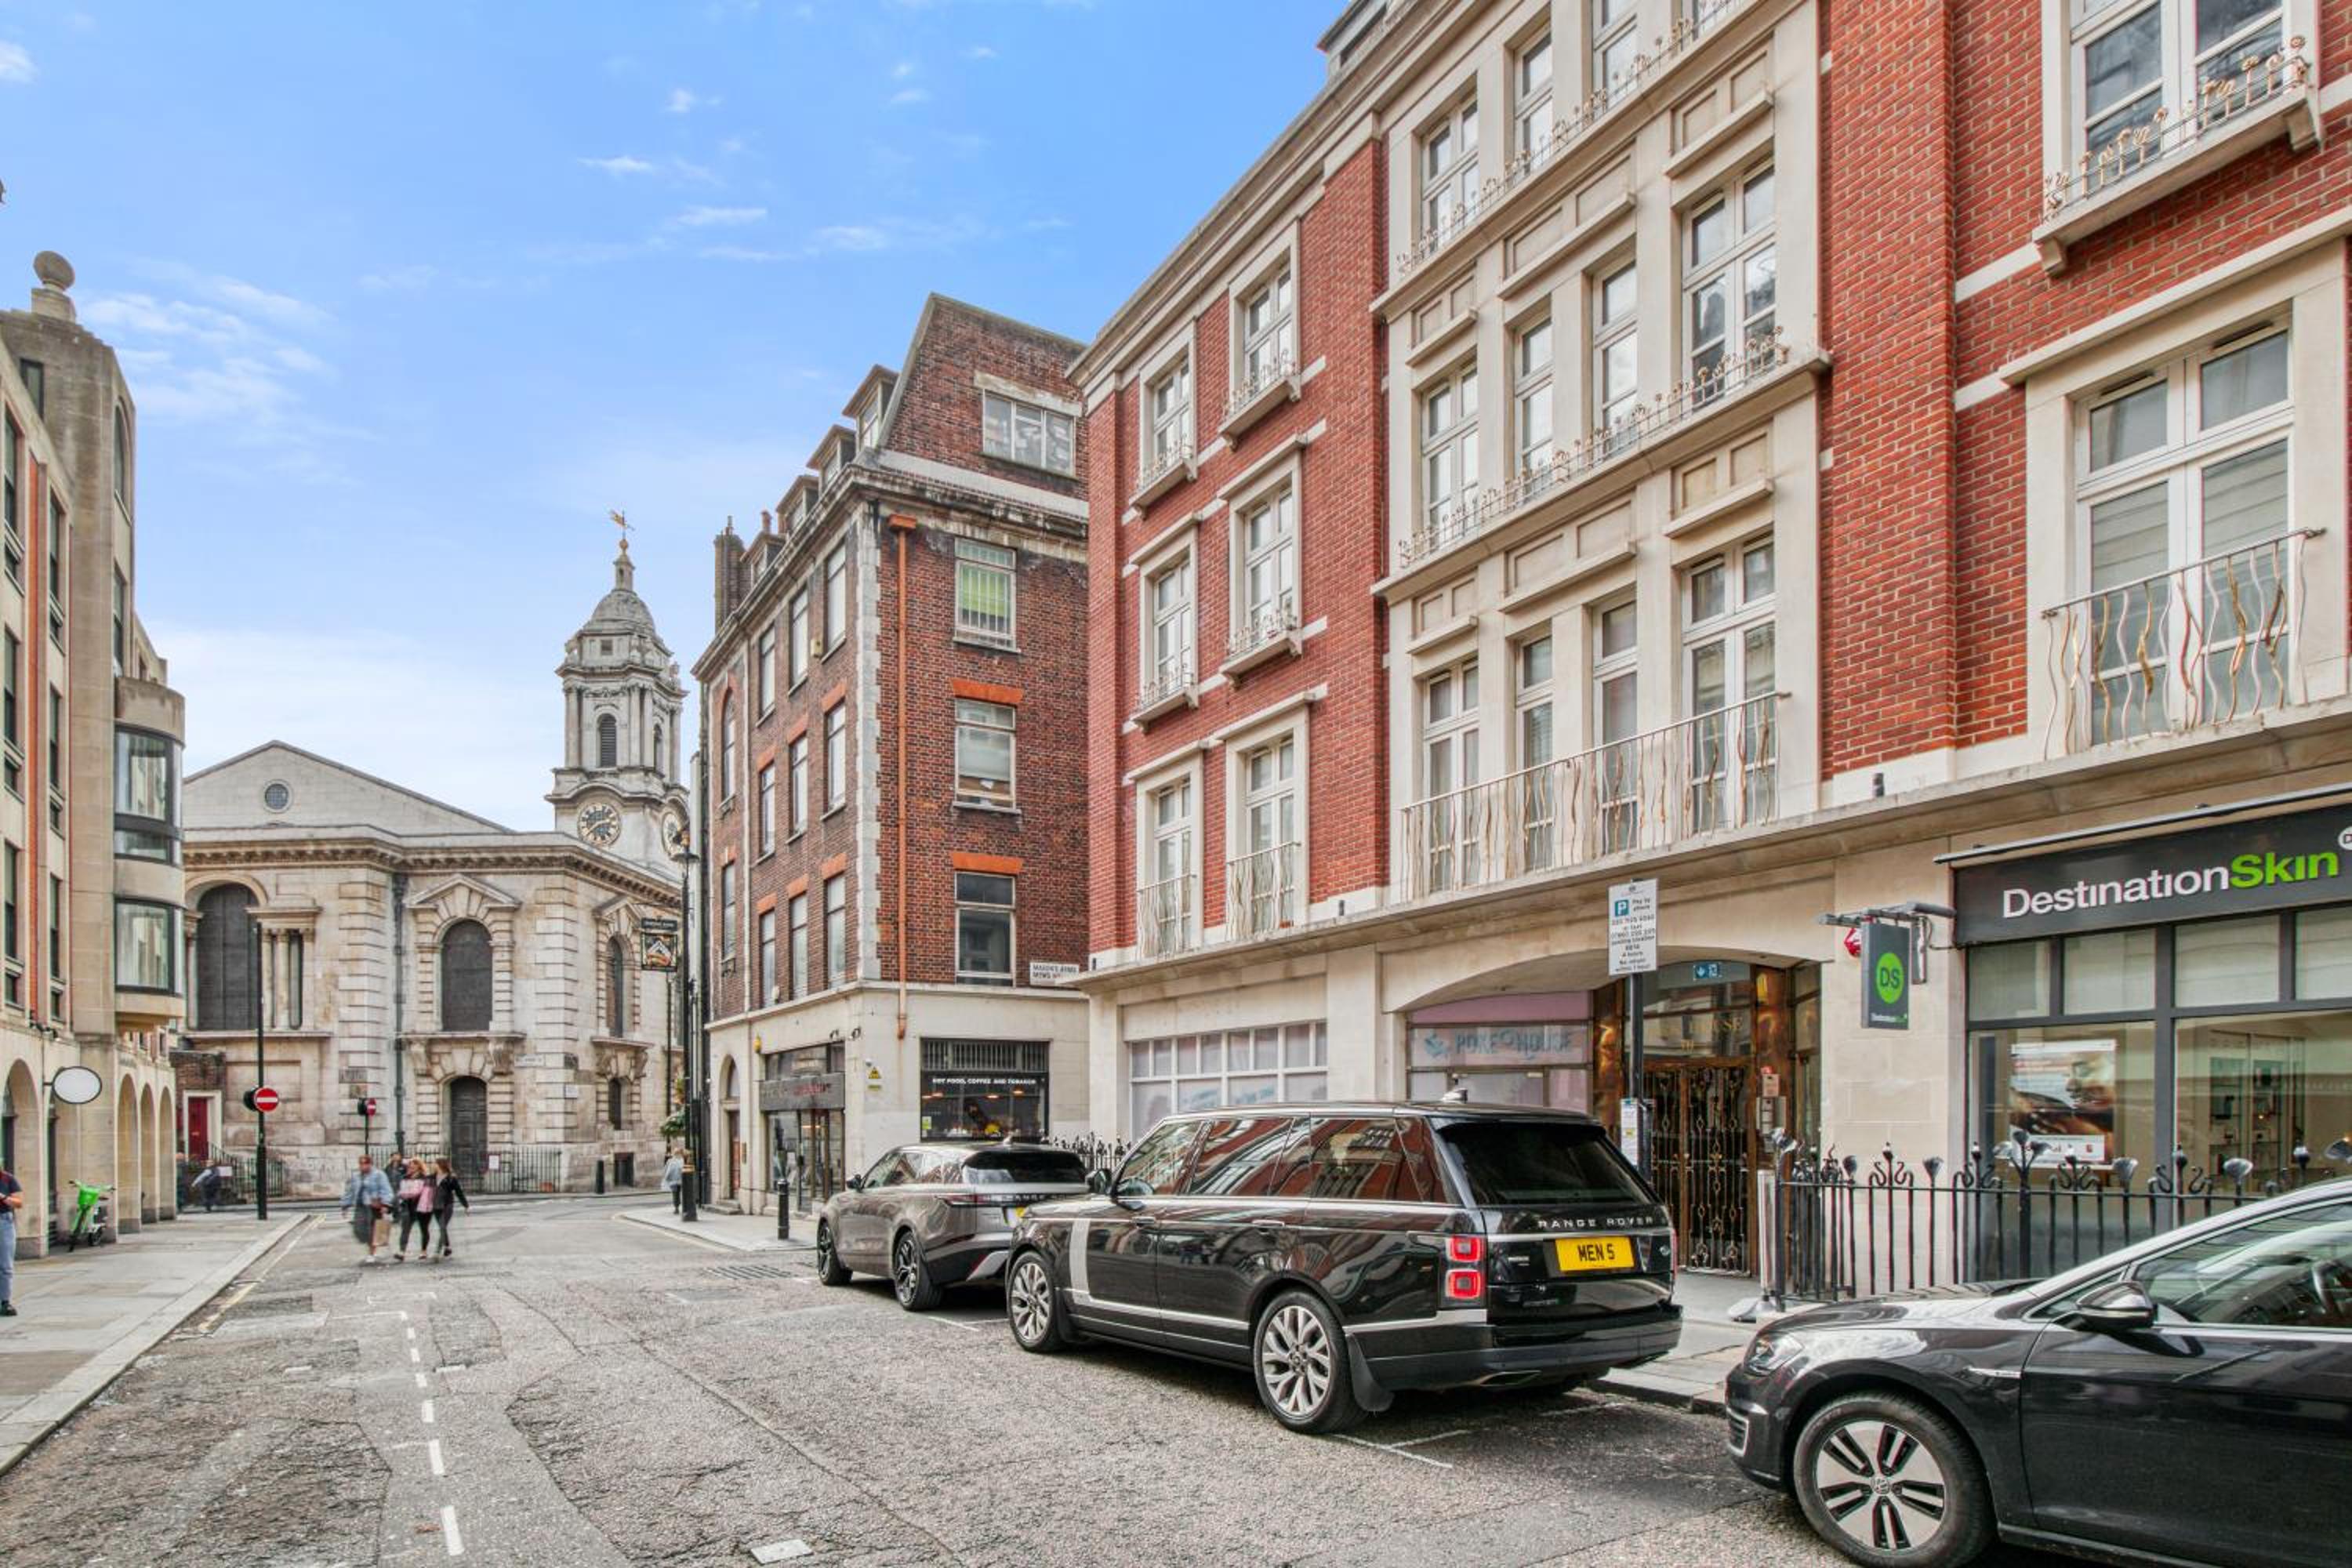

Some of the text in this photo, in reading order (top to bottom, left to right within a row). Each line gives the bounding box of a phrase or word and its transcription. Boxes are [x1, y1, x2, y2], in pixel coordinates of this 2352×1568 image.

[2002, 851, 2338, 918] DestinationSkin
[1880, 967, 1901, 989] DS
[1537, 1217, 1653, 1229] RANGE ROVER
[1577, 1244, 1604, 1261] MEN
